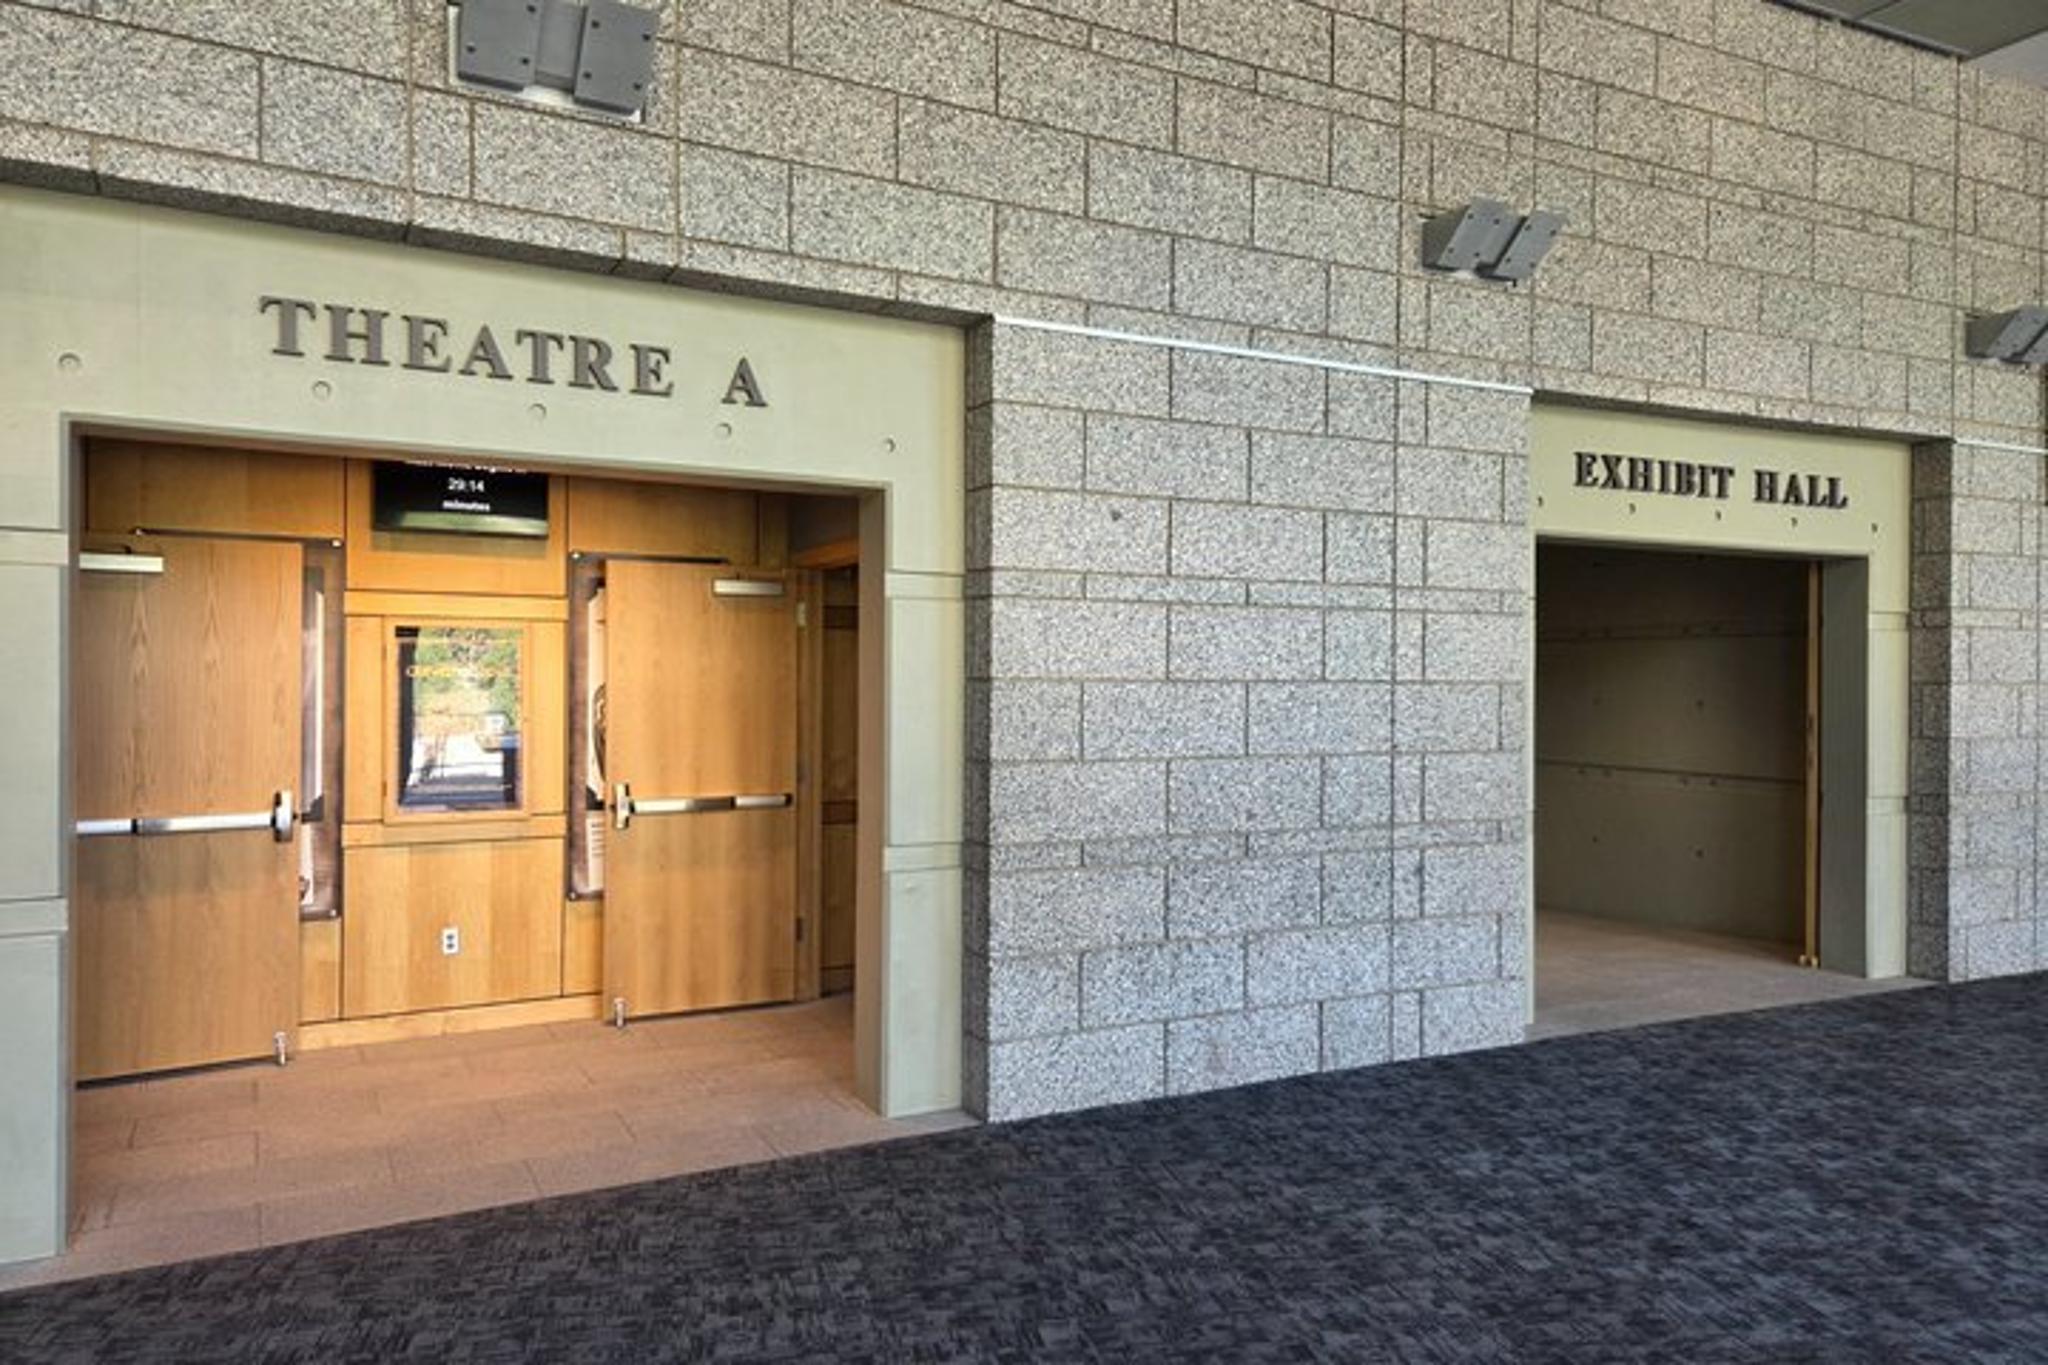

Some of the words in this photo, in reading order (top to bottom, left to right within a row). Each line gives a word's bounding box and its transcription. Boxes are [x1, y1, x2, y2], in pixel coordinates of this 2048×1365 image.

[259, 295, 674, 398] THEATRE
[721, 357, 768, 408] A
[442, 499, 491, 512] minutes
[1573, 451, 1735, 499] EXHIBIT
[1754, 469, 1848, 510] HALL
